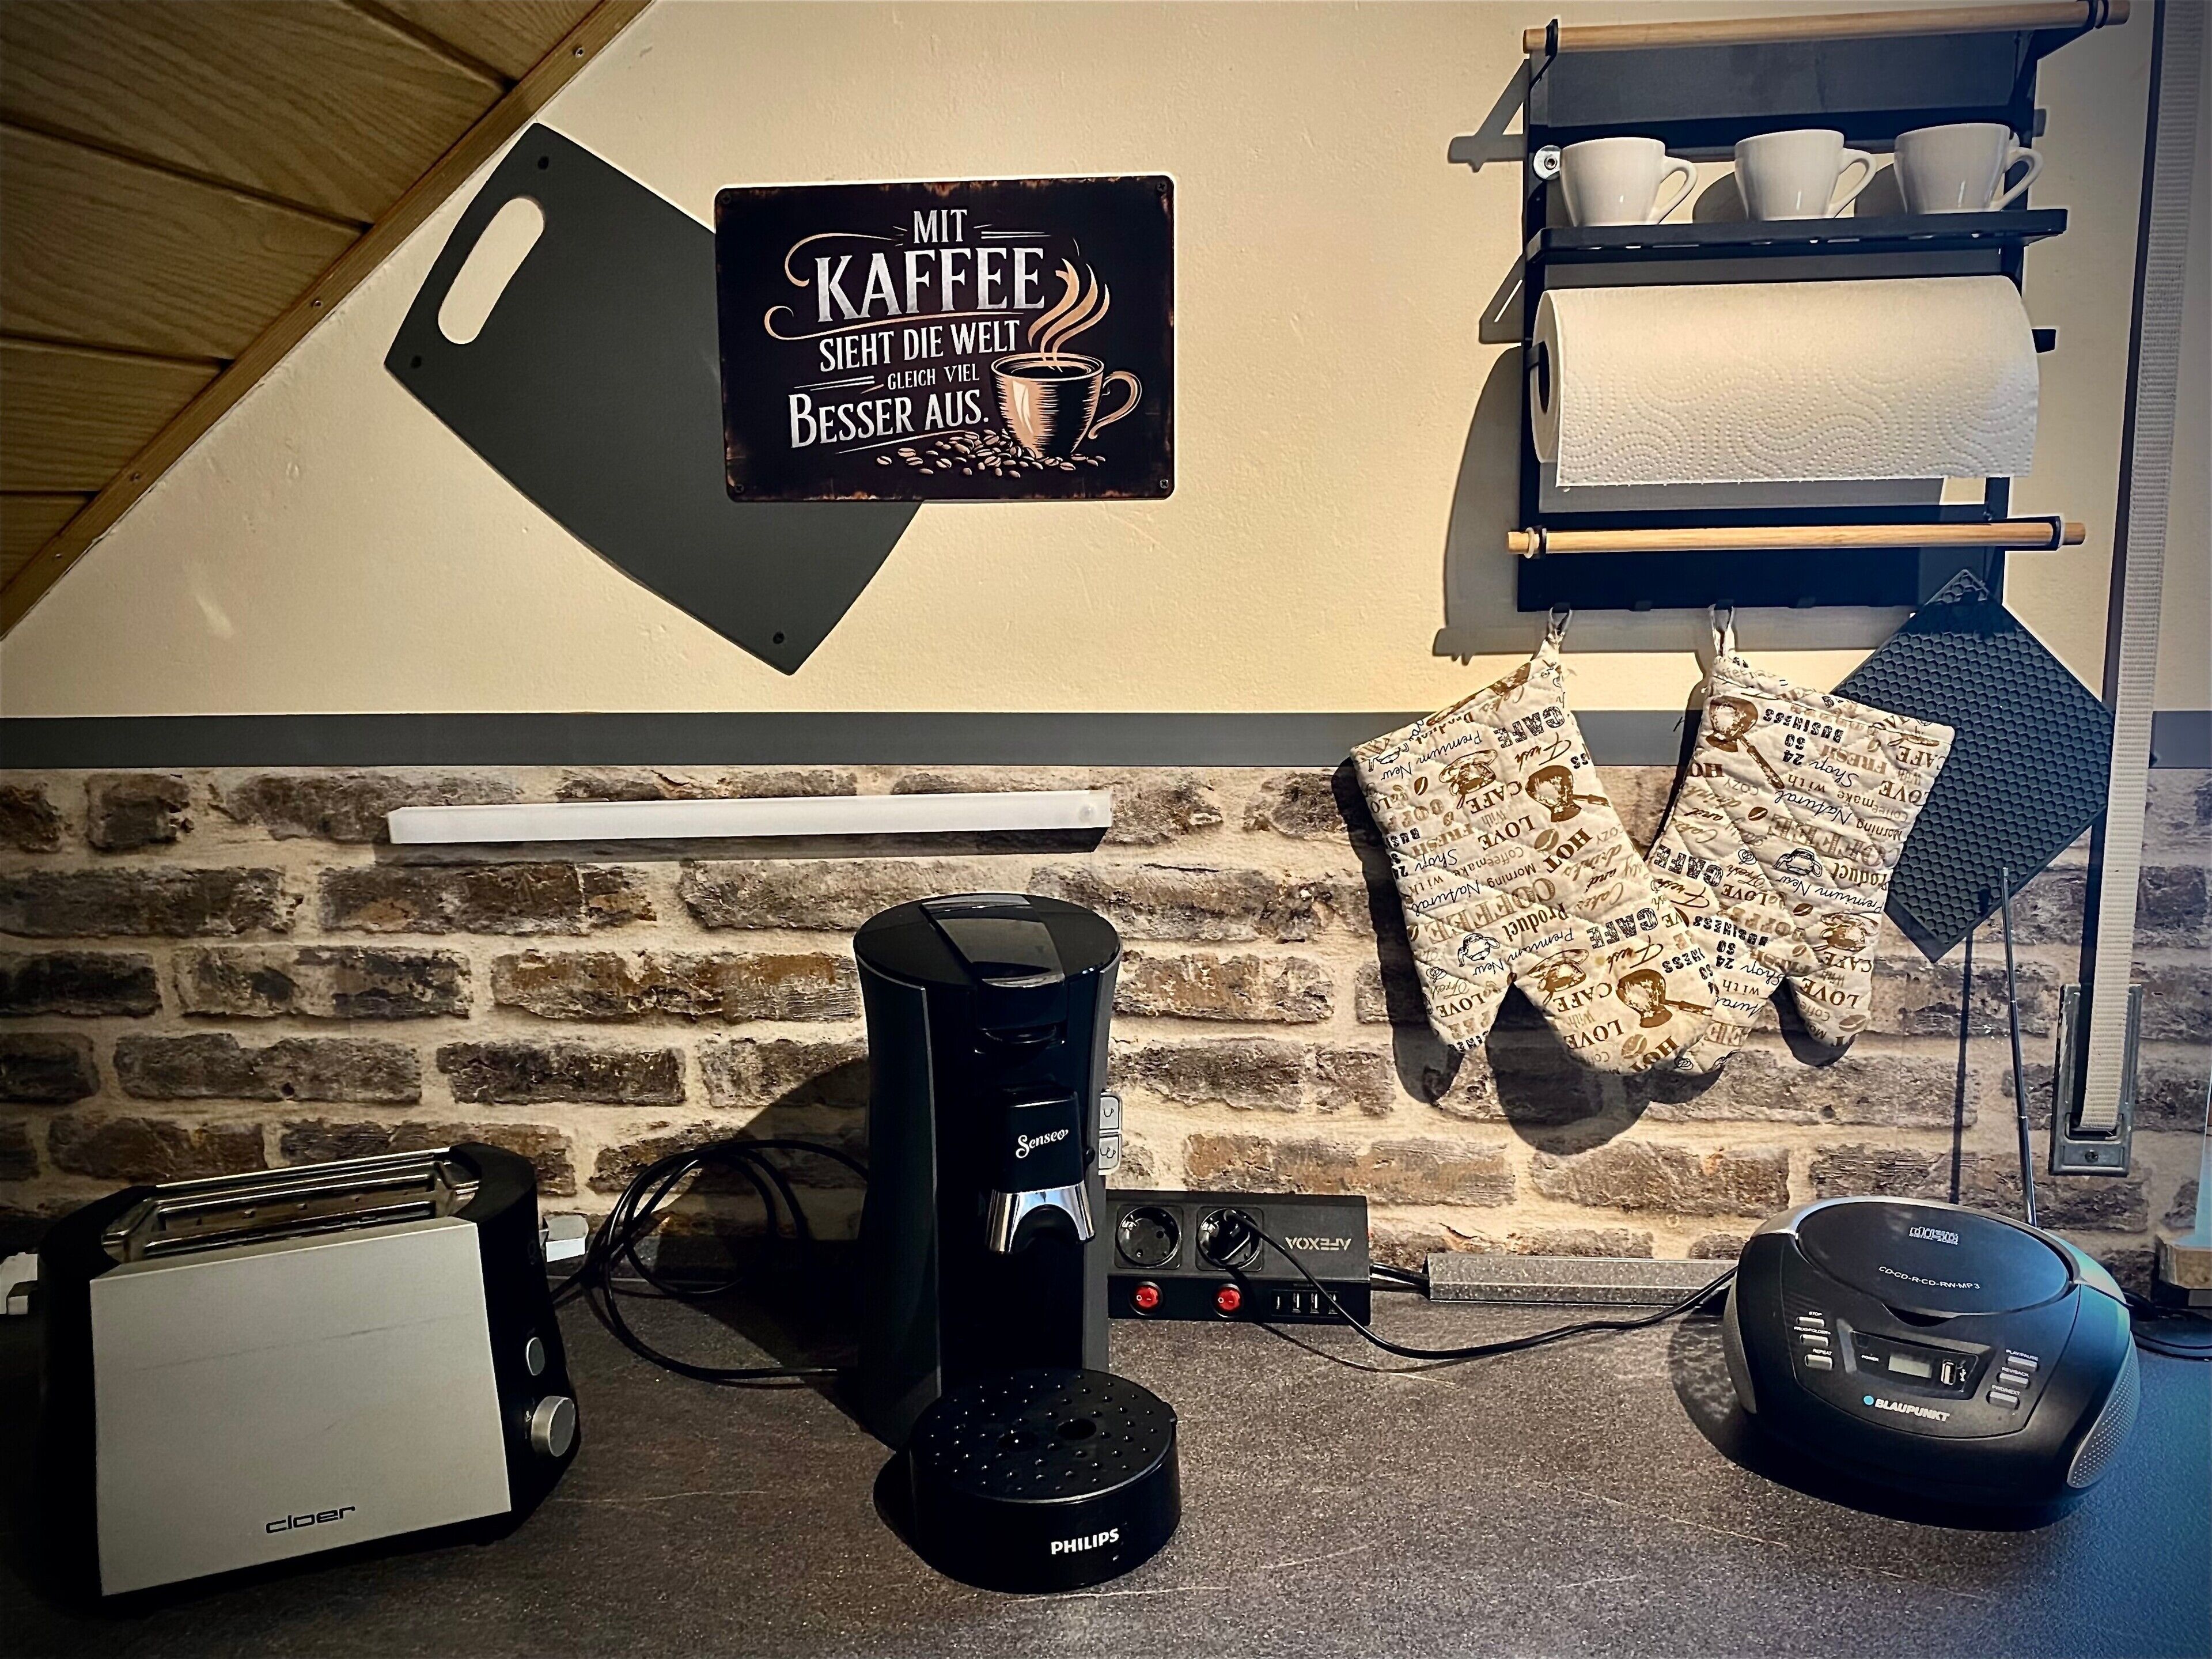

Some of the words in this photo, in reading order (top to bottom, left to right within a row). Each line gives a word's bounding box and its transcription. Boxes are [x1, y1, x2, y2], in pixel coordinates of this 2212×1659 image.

[913, 209, 967, 244] MIT
[815, 248, 1046, 323] KAFFEE
[819, 330, 895, 373] SIEHT
[904, 325, 944, 359] DIE
[950, 319, 1020, 355] WELT
[888, 368, 936, 391] GLEICH
[945, 363, 980, 384] VIEL
[925, 389, 989, 430] AUS.
[1494, 706, 1565, 749] CAFE
[1762, 708, 1845, 743] BUSINESS
[1416, 730, 1483, 766] Premium
[1514, 732, 1572, 772] Fresh
[1785, 733, 1806, 751] SO
[1381, 762, 1412, 782] New
[1782, 750, 1802, 766] 24
[1819, 744, 1888, 775] FRESH
[1895, 746, 1947, 771] CAFE
[1724, 778, 1760, 797] COZY
[1787, 774, 1825, 793] with
[1809, 760, 1860, 788] Shop
[1465, 781, 1522, 815] CAFE
[1774, 789, 1853, 826] Natural
[1837, 791, 1874, 809] make
[1481, 809, 1508, 828] With
[1684, 808, 1724, 821] and
[1411, 822, 1476, 858] FRESH
[1478, 815, 1536, 852] LOVE
[1767, 813, 1901, 867] COFFEE
[1856, 817, 1903, 842] Morning
[1414, 848, 1458, 872] Shop
[1477, 846, 1524, 870] Coffee
[1543, 828, 1593, 874] HOT
[1562, 843, 1623, 881] drinks
[1452, 860, 1479, 877] make
[1487, 863, 1537, 887] Morning
[1654, 844, 1723, 887] CAFE
[1726, 862, 1766, 890] Fresh
[1407, 875, 1444, 895] with
[1585, 868, 1618, 893] and
[1778, 875, 1814, 894] New
[1412, 879, 1480, 917] Natural
[1721, 884, 1770, 907] LOVE
[1815, 887, 1886, 912] Premium
[1428, 877, 1555, 946] COFFEE
[1502, 902, 1568, 942] Product
[1586, 907, 1658, 950] CAFE
[1692, 915, 1769, 946] BUSINESS
[1505, 927, 1574, 963] Premium
[1607, 935, 1664, 975] Fresh
[1717, 940, 1736, 955] SO
[1473, 959, 1505, 977] New
[1715, 955, 1735, 969] 24
[1740, 963, 1785, 987] Shop
[1821, 950, 1873, 974] CAFE
[1552, 982, 1612, 1013] CAFE
[1722, 978, 1760, 995] with
[1800, 978, 1860, 1008] LOVE
[1436, 993, 1486, 1018] LOVE
[1564, 1019, 1625, 1050] LOVE
[1628, 1036, 1681, 1074] HOT
[1016, 1128, 1069, 1159] Senseo
[1874, 1398, 1950, 1422] BLAUPUNKT
[266, 1505, 356, 1534] cloer
[1051, 1528, 1120, 1555] PHILIPS
